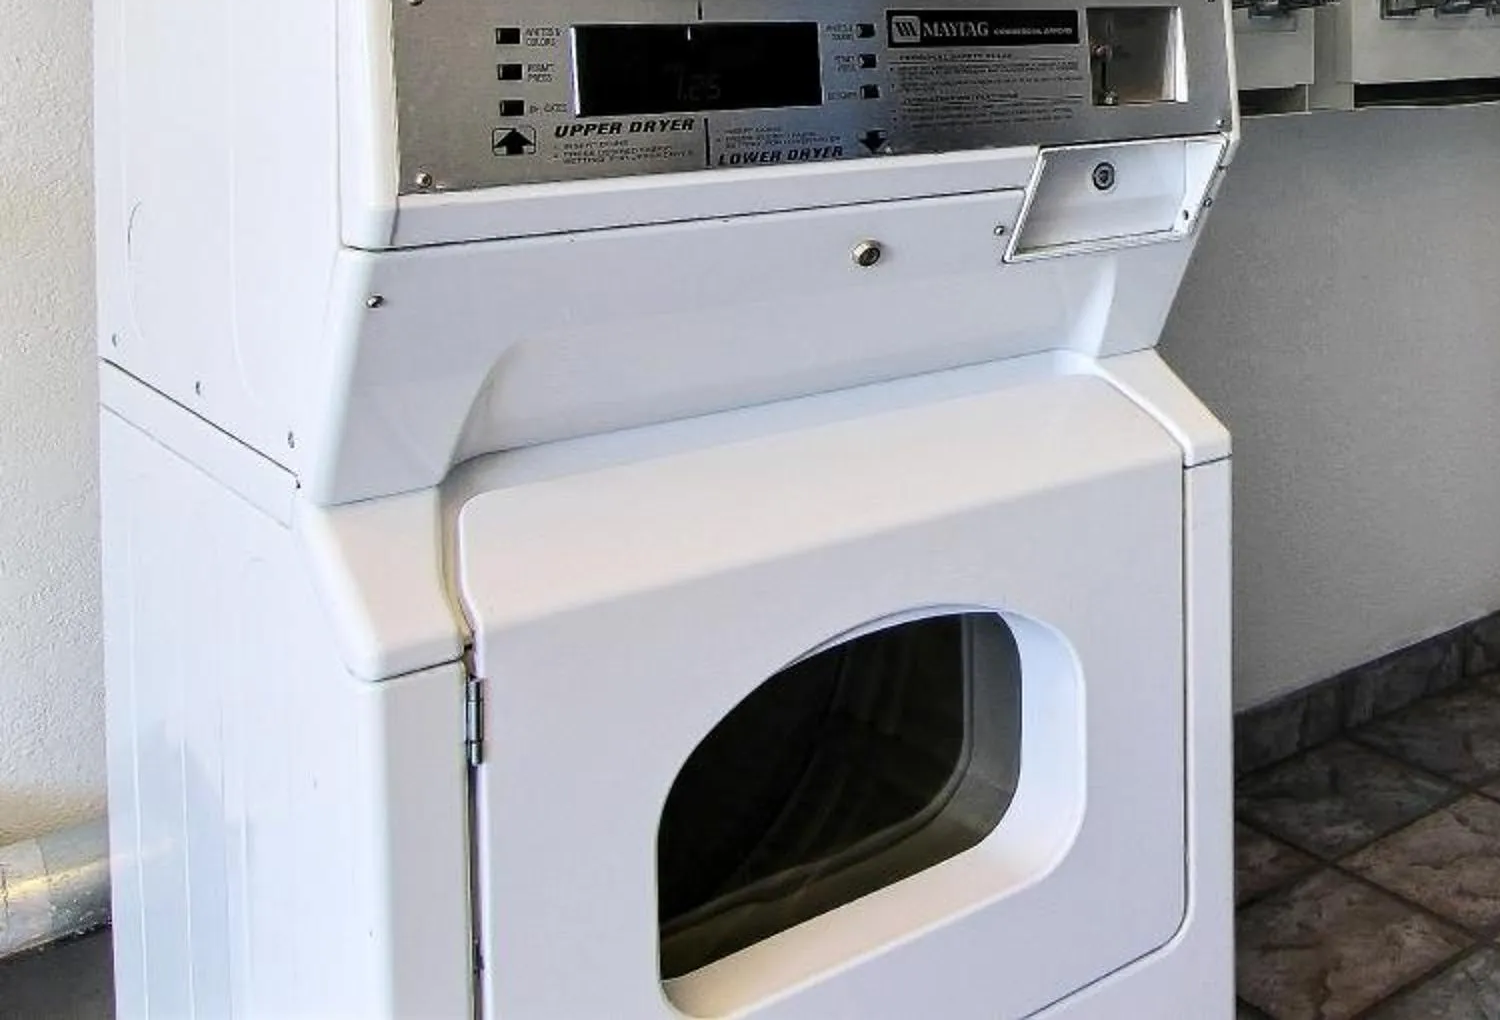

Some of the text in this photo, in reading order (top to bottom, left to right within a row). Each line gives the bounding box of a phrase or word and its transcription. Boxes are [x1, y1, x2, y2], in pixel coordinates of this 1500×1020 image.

[922, 21, 989, 38] MAYTAG
[554, 117, 695, 139] UPPER DRYER
[717, 145, 843, 167] LOWER DRYER
